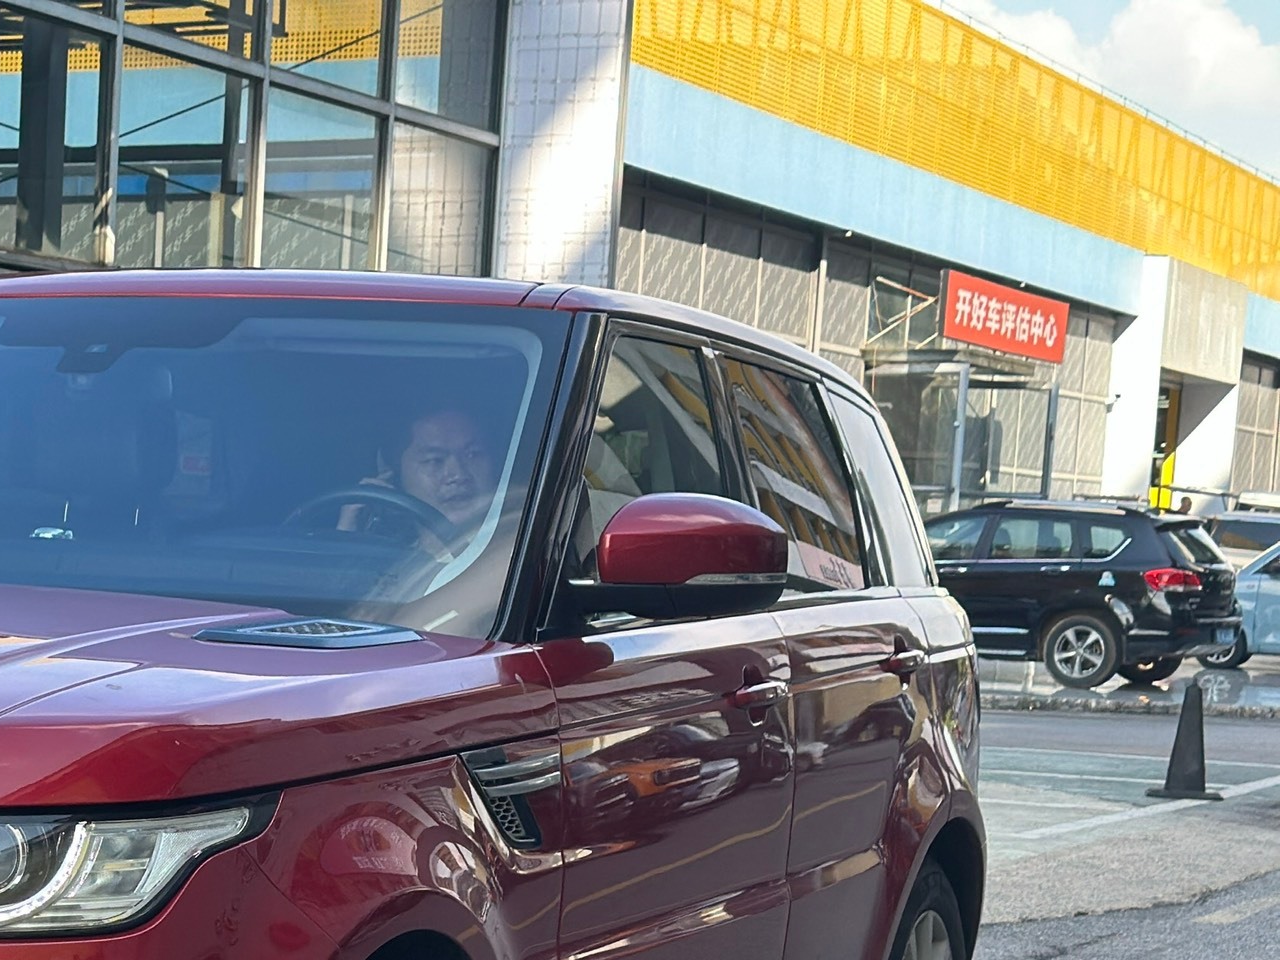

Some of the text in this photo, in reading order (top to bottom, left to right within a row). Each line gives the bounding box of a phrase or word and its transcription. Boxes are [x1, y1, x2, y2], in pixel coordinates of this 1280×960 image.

[954, 289, 1057, 347] 开好车评估中心
